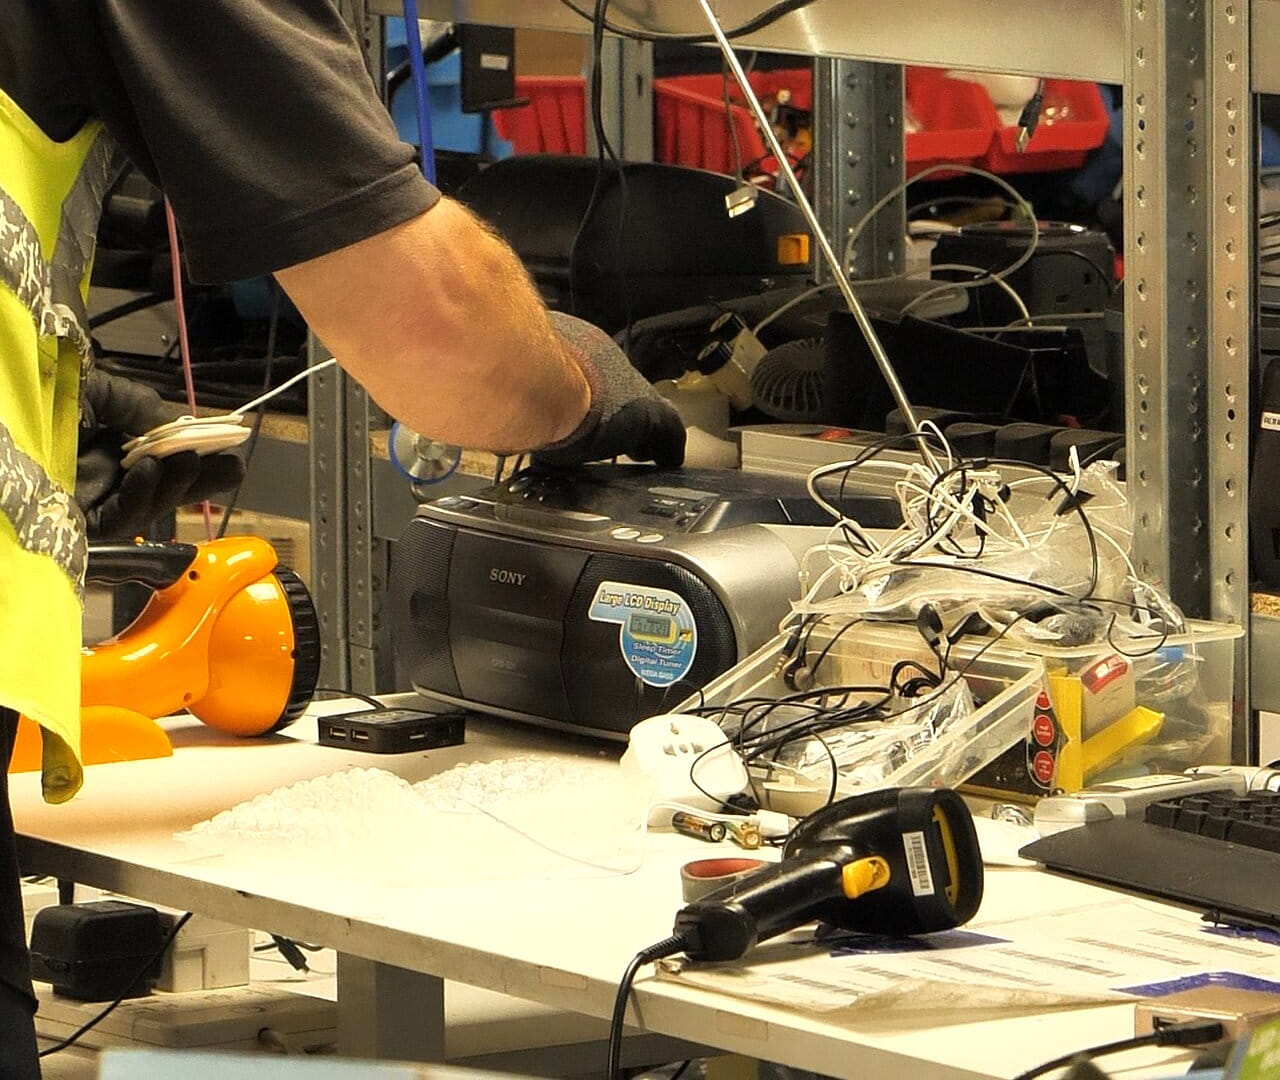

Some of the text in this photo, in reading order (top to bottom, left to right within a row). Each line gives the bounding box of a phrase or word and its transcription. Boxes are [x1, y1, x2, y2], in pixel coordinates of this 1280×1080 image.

[489, 568, 527, 586] SONY
[599, 590, 681, 615] Large LCD Display
[633, 642, 682, 655] Sleep Timer
[631, 654, 658, 667] Digital
